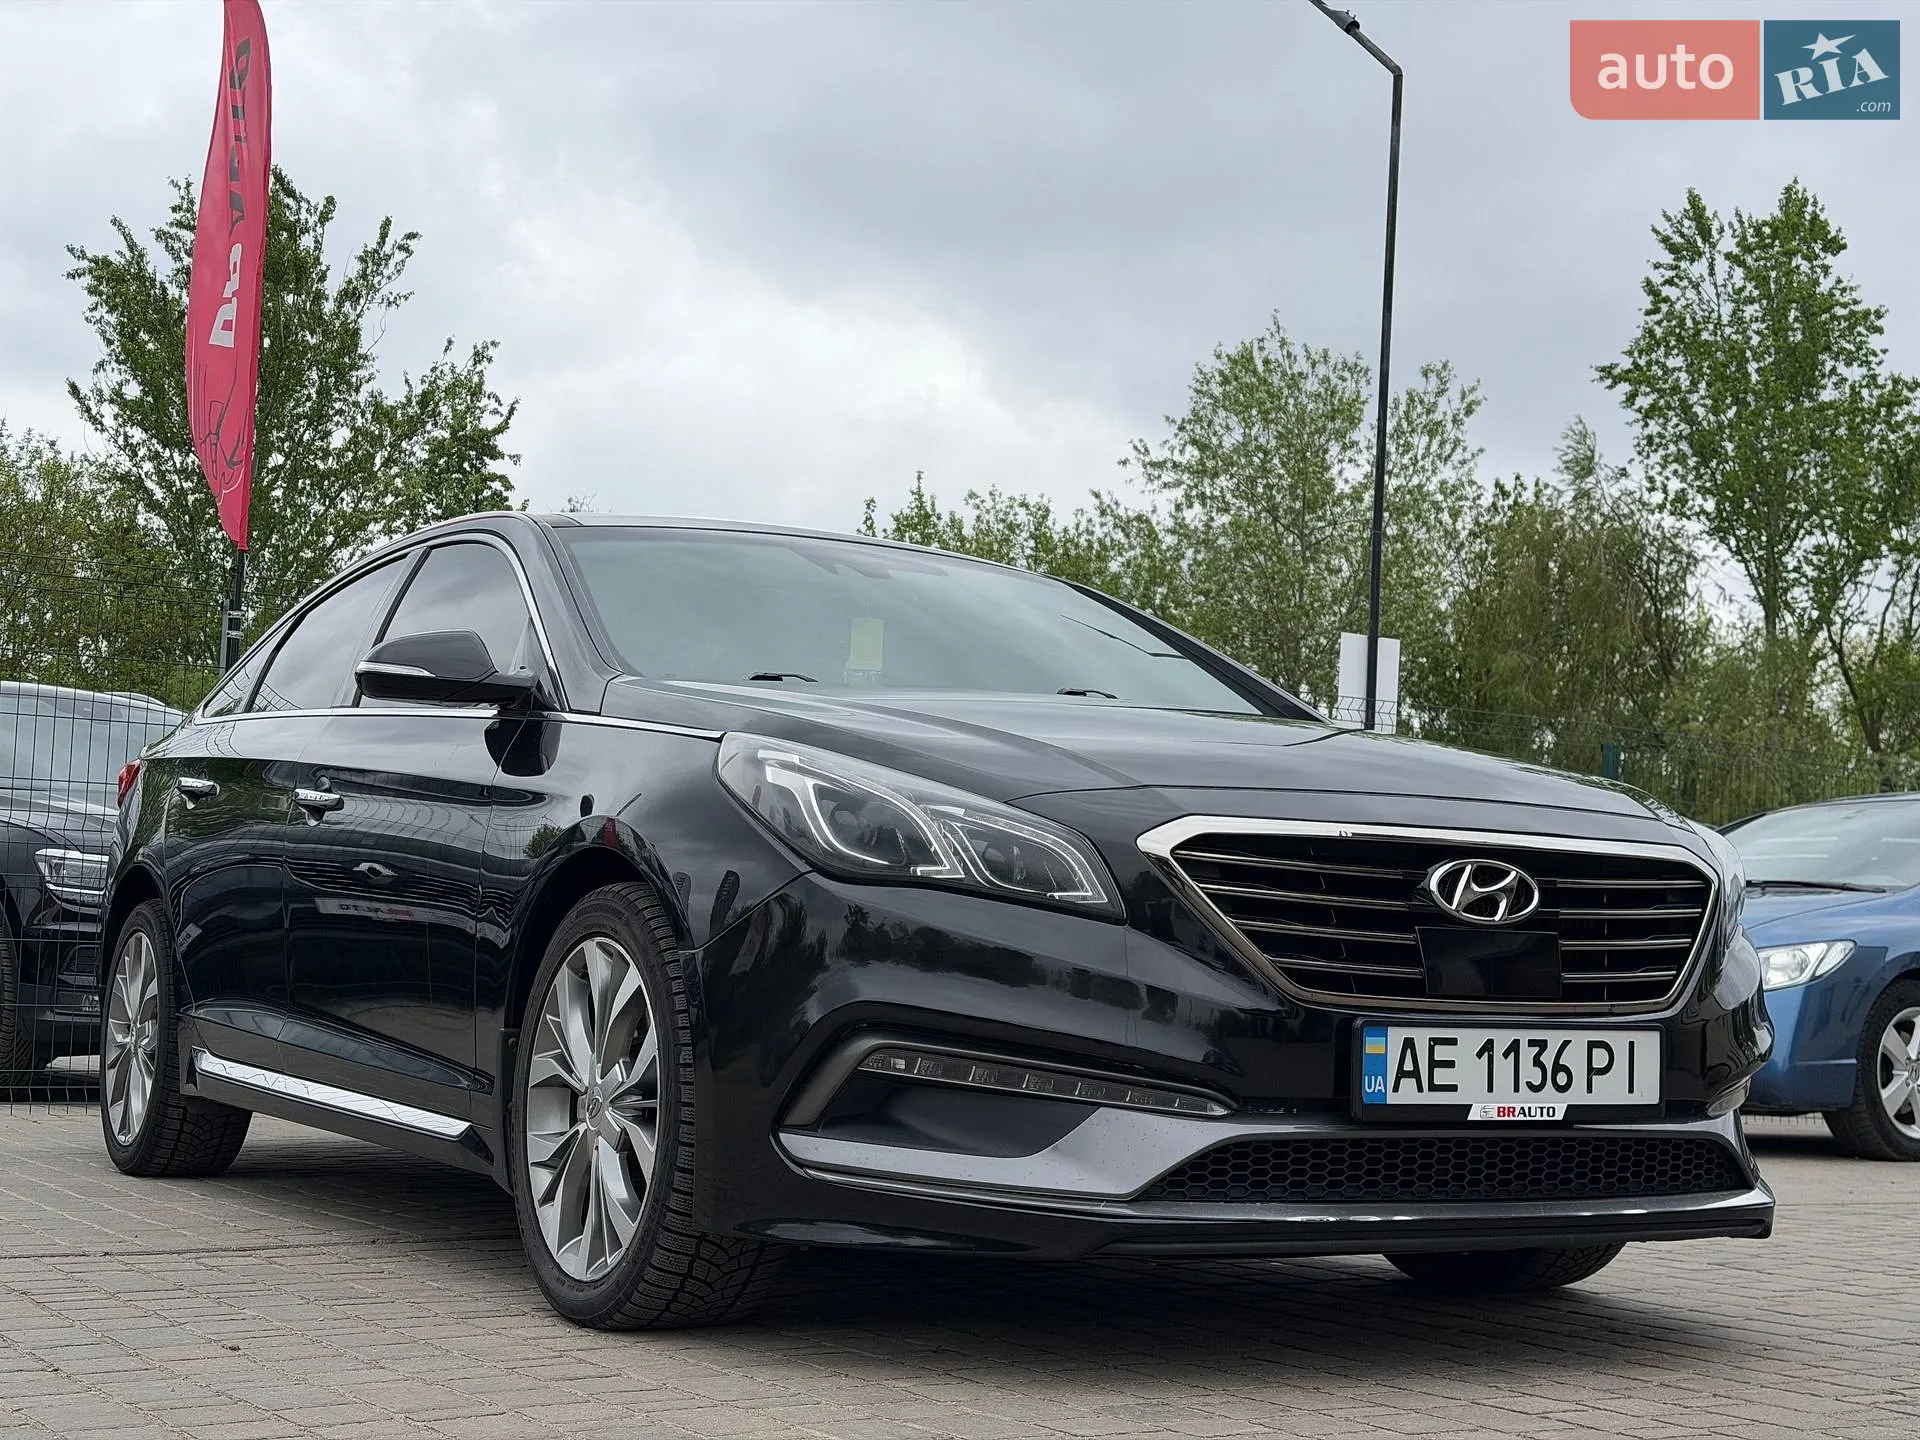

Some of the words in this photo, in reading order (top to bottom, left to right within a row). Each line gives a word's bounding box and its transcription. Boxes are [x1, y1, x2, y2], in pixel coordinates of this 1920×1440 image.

[1392, 1036, 1458, 1093] AE
[1475, 1038, 1574, 1093] 1136
[1586, 1040, 1635, 1094] PI
[1364, 1075, 1385, 1093] UA
[1496, 1106, 1556, 1118] BRAUTO
